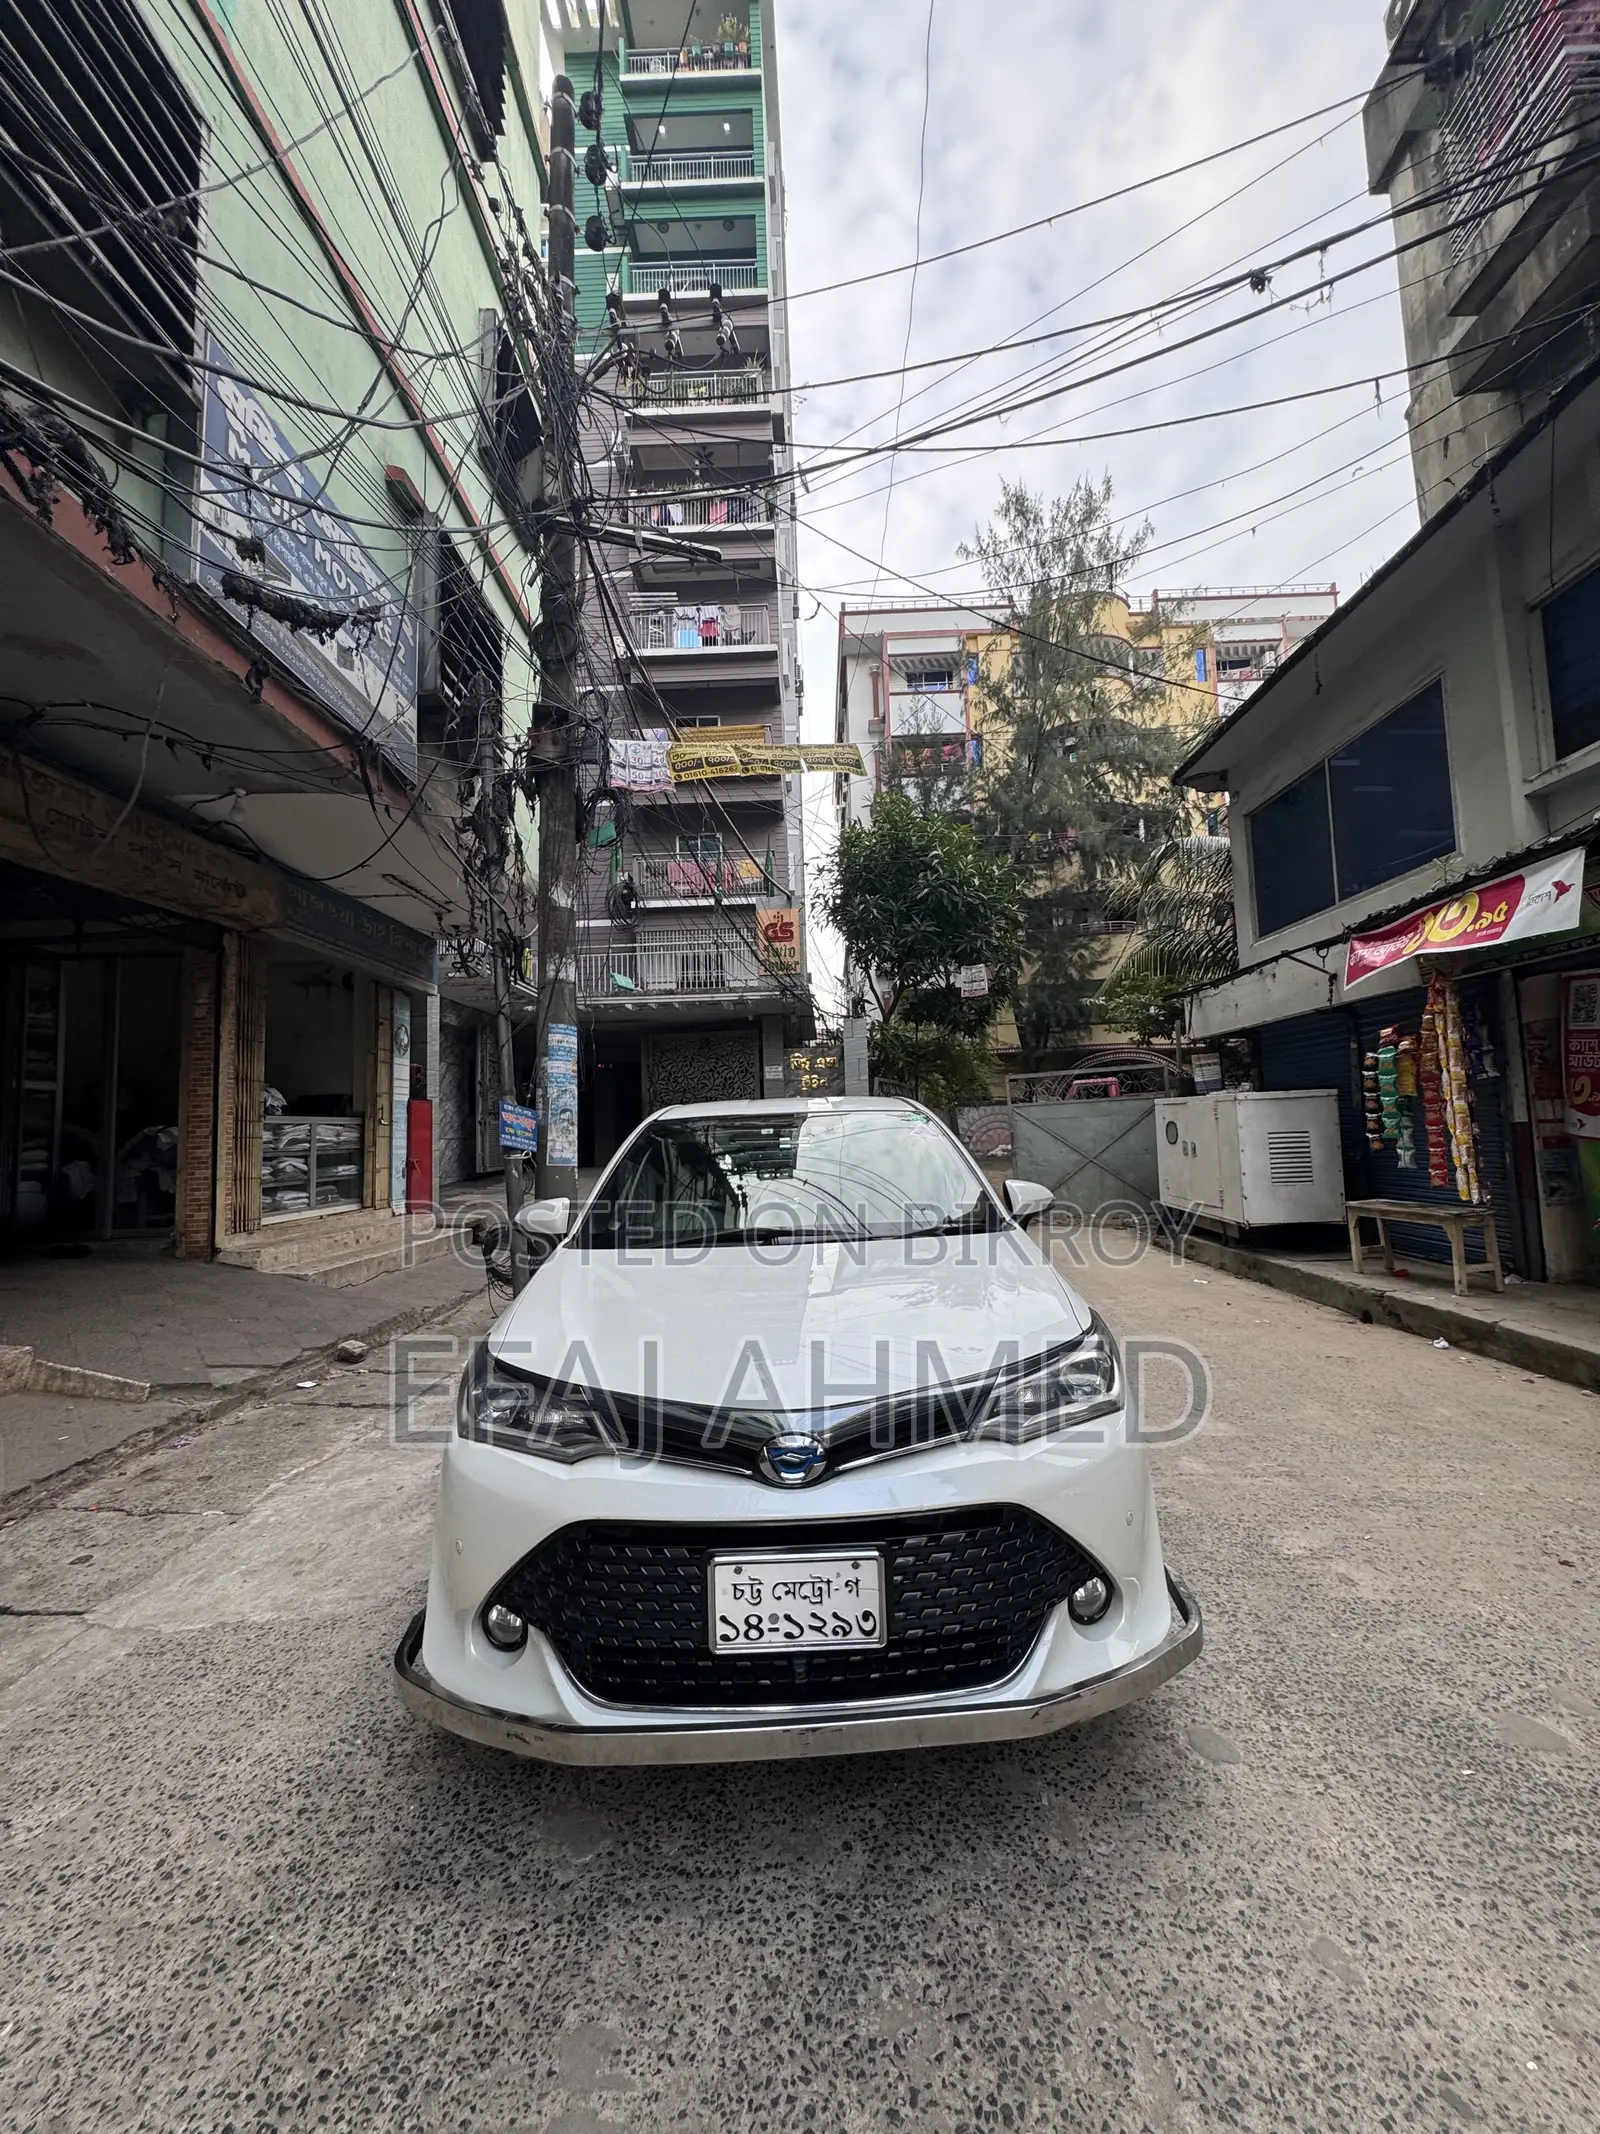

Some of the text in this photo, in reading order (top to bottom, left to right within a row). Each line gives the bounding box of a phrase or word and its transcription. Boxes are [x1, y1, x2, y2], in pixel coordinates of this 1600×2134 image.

[631, 756, 643, 765] 30
[632, 772, 644, 780] 50
[764, 921, 794, 942] GS
[731, 1576, 765, 1606] চট্ট
[719, 1610, 877, 1642] ১৪-১২৯৩
